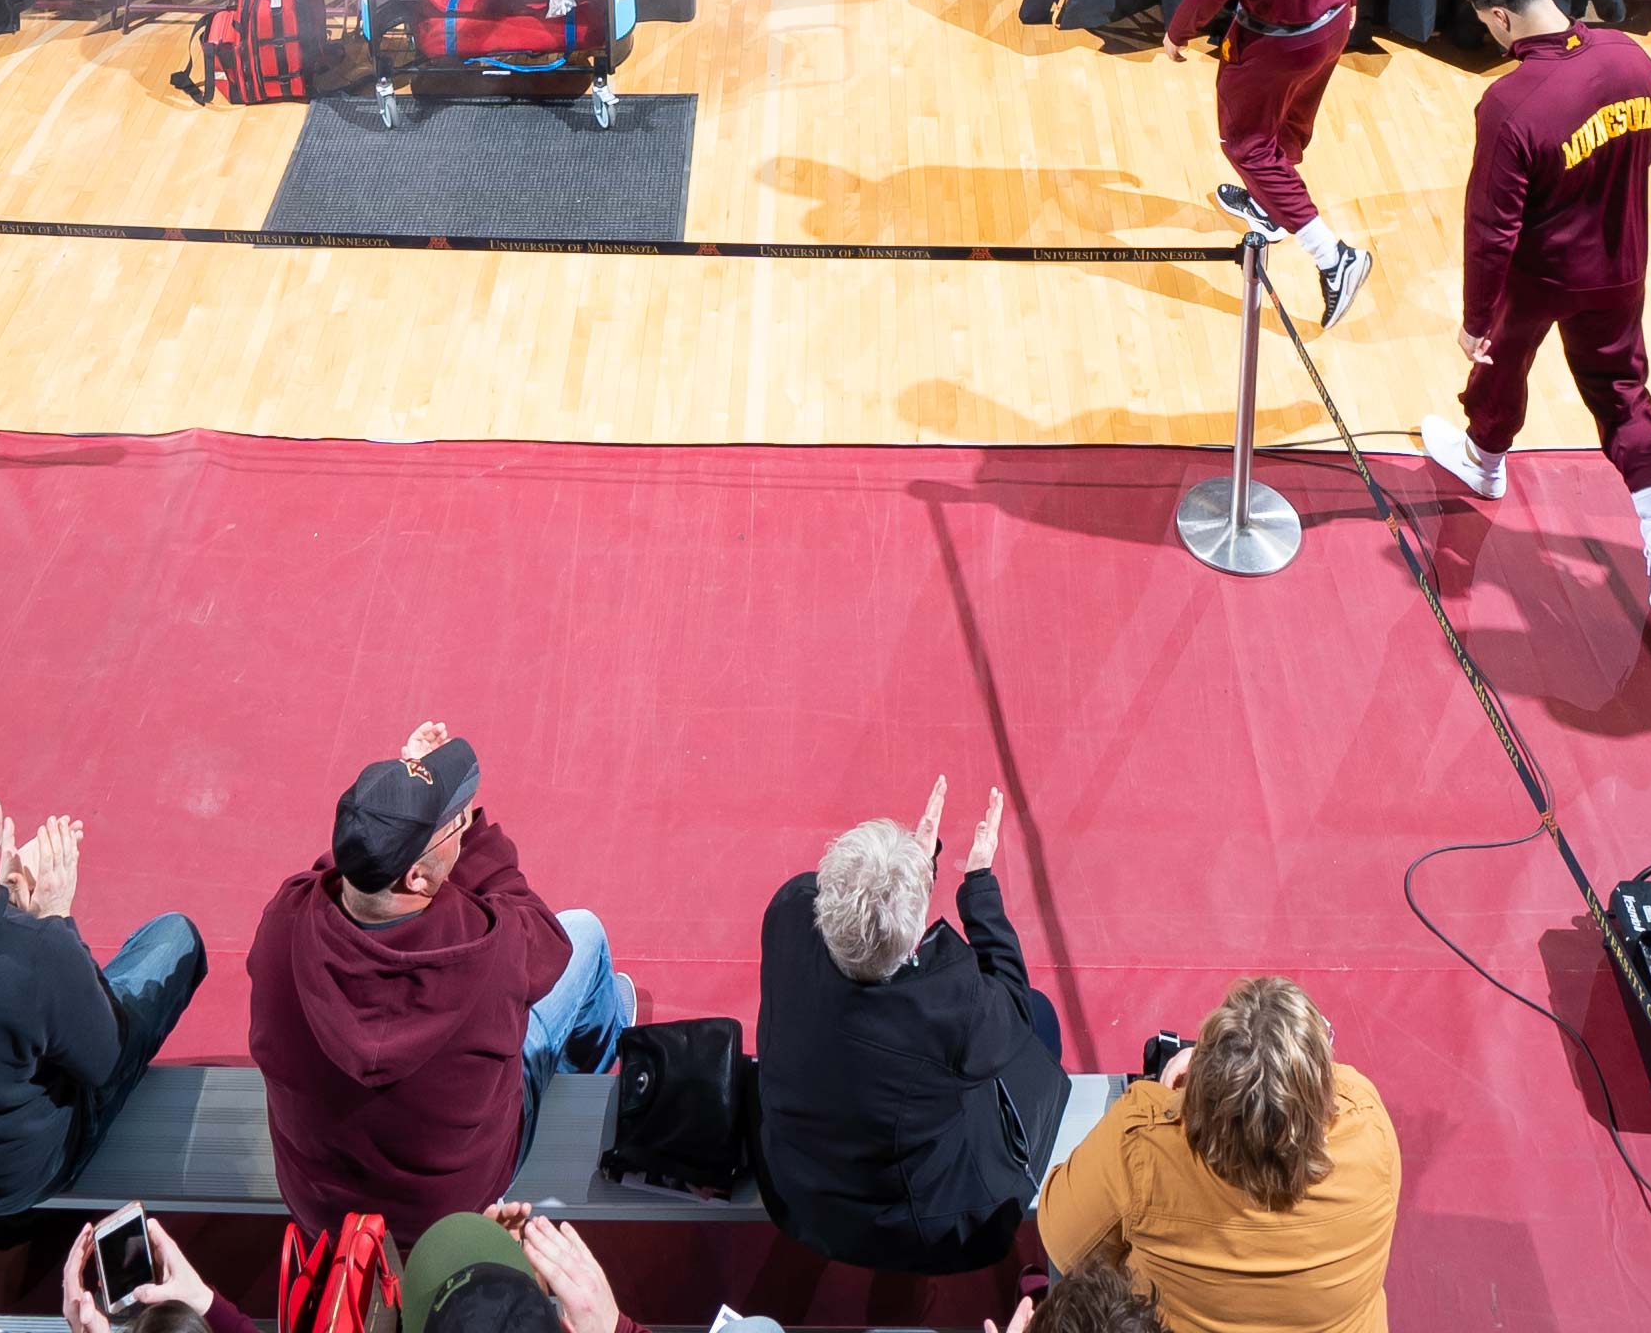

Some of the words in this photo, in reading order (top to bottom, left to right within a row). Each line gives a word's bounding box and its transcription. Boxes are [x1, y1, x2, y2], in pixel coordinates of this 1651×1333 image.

[56, 226, 126, 238] MINNESOTA
[1033, 249, 1109, 261] UNIVERSITY
[1132, 249, 1206, 261] MINNESOTA
[1585, 888, 1646, 1003] UNIVERSITY
